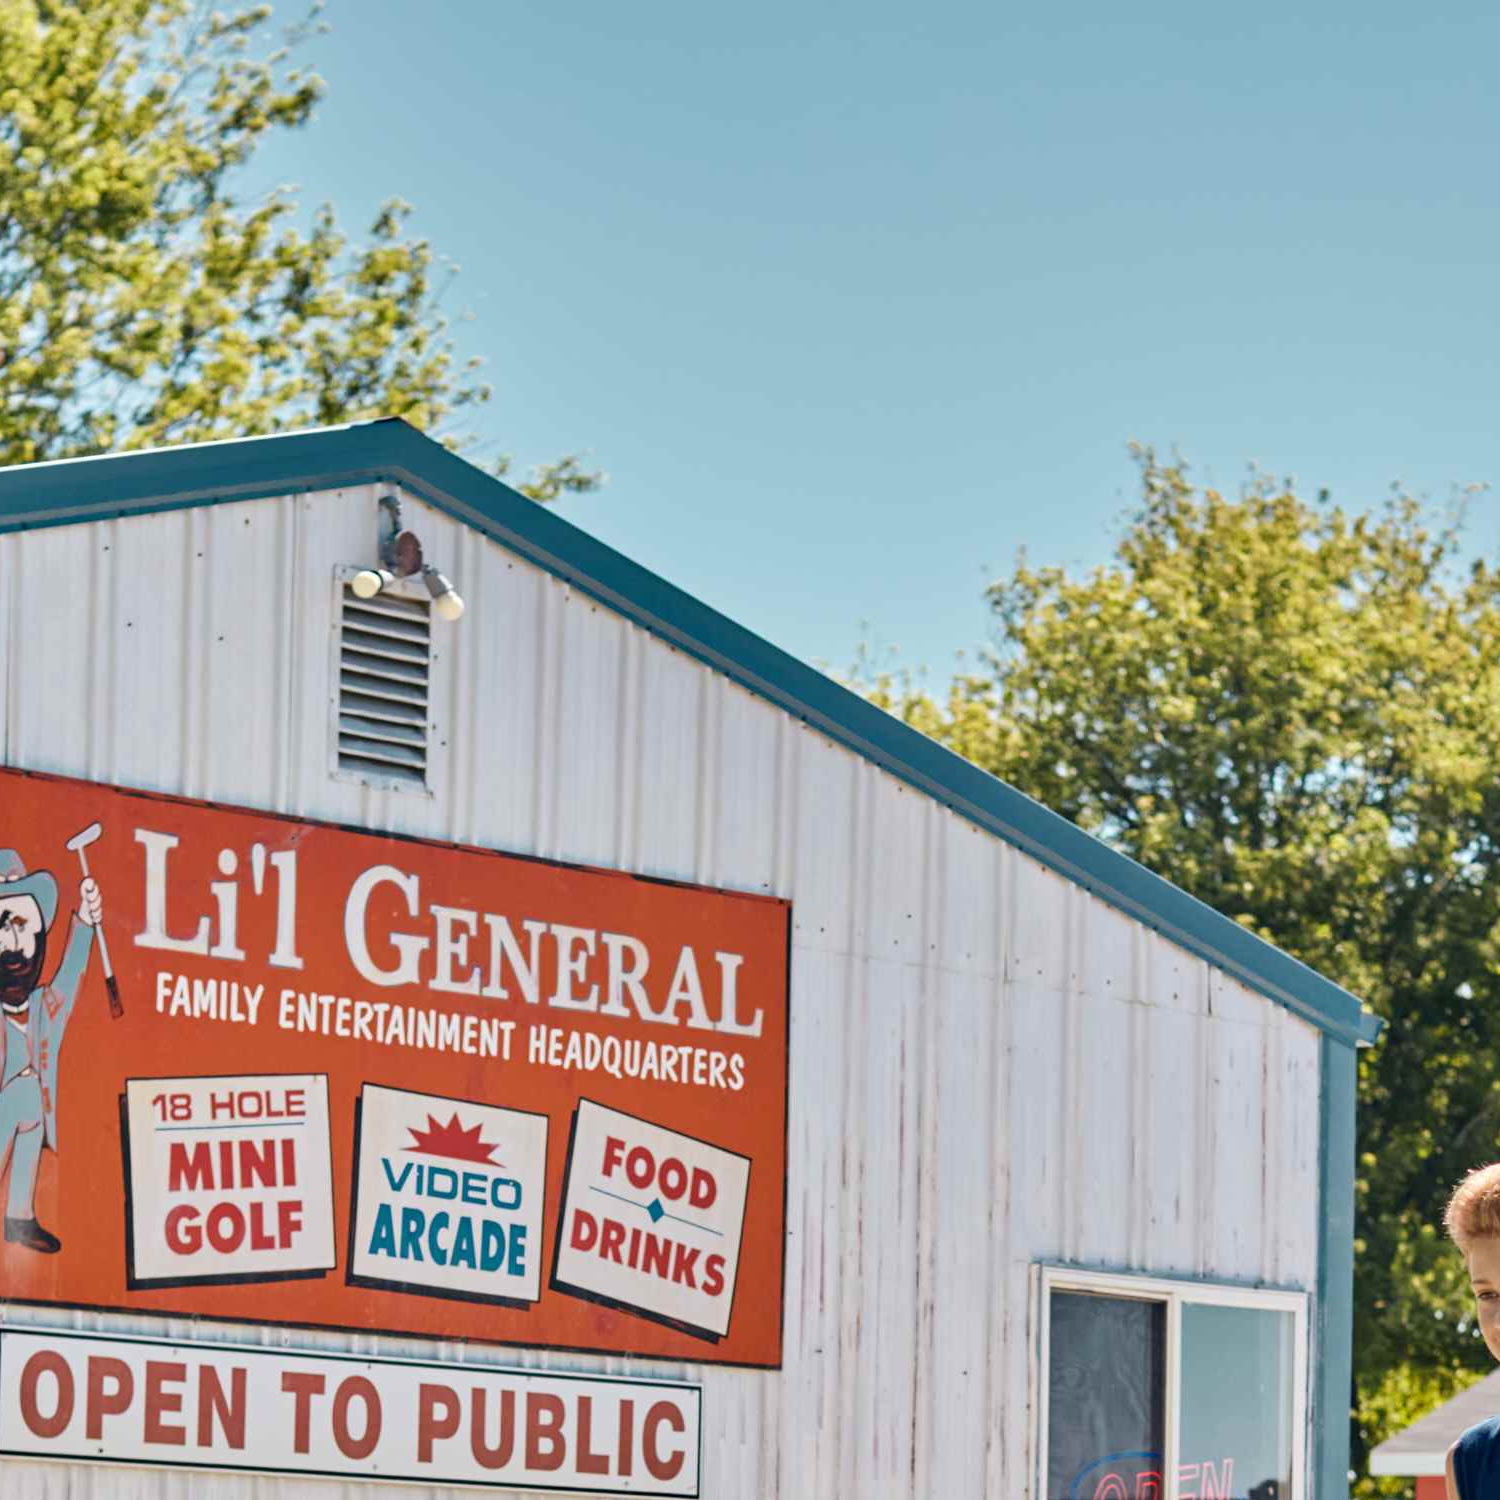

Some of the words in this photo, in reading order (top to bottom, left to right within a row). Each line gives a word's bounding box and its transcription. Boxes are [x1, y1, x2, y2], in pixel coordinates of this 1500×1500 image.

[134, 828, 303, 969] Li'l
[344, 865, 763, 1038] GENERAL
[156, 973, 264, 1025] FAMILY
[279, 990, 515, 1060] ENTERTAINMENT
[529, 1025, 745, 1090] HEADQUARTERS
[152, 1092, 191, 1122] 18
[211, 1090, 306, 1120] HOLE
[168, 1139, 296, 1192] MINI
[381, 1158, 522, 1211] VIDEO
[601, 1136, 717, 1210] FOOD
[164, 1201, 302, 1255] GOLF
[368, 1203, 526, 1277] ARCADE
[570, 1209, 725, 1297] DRINKS
[19, 1350, 247, 1450] OPEN
[281, 1371, 381, 1460] TO
[417, 1383, 685, 1481] PUBLIC
